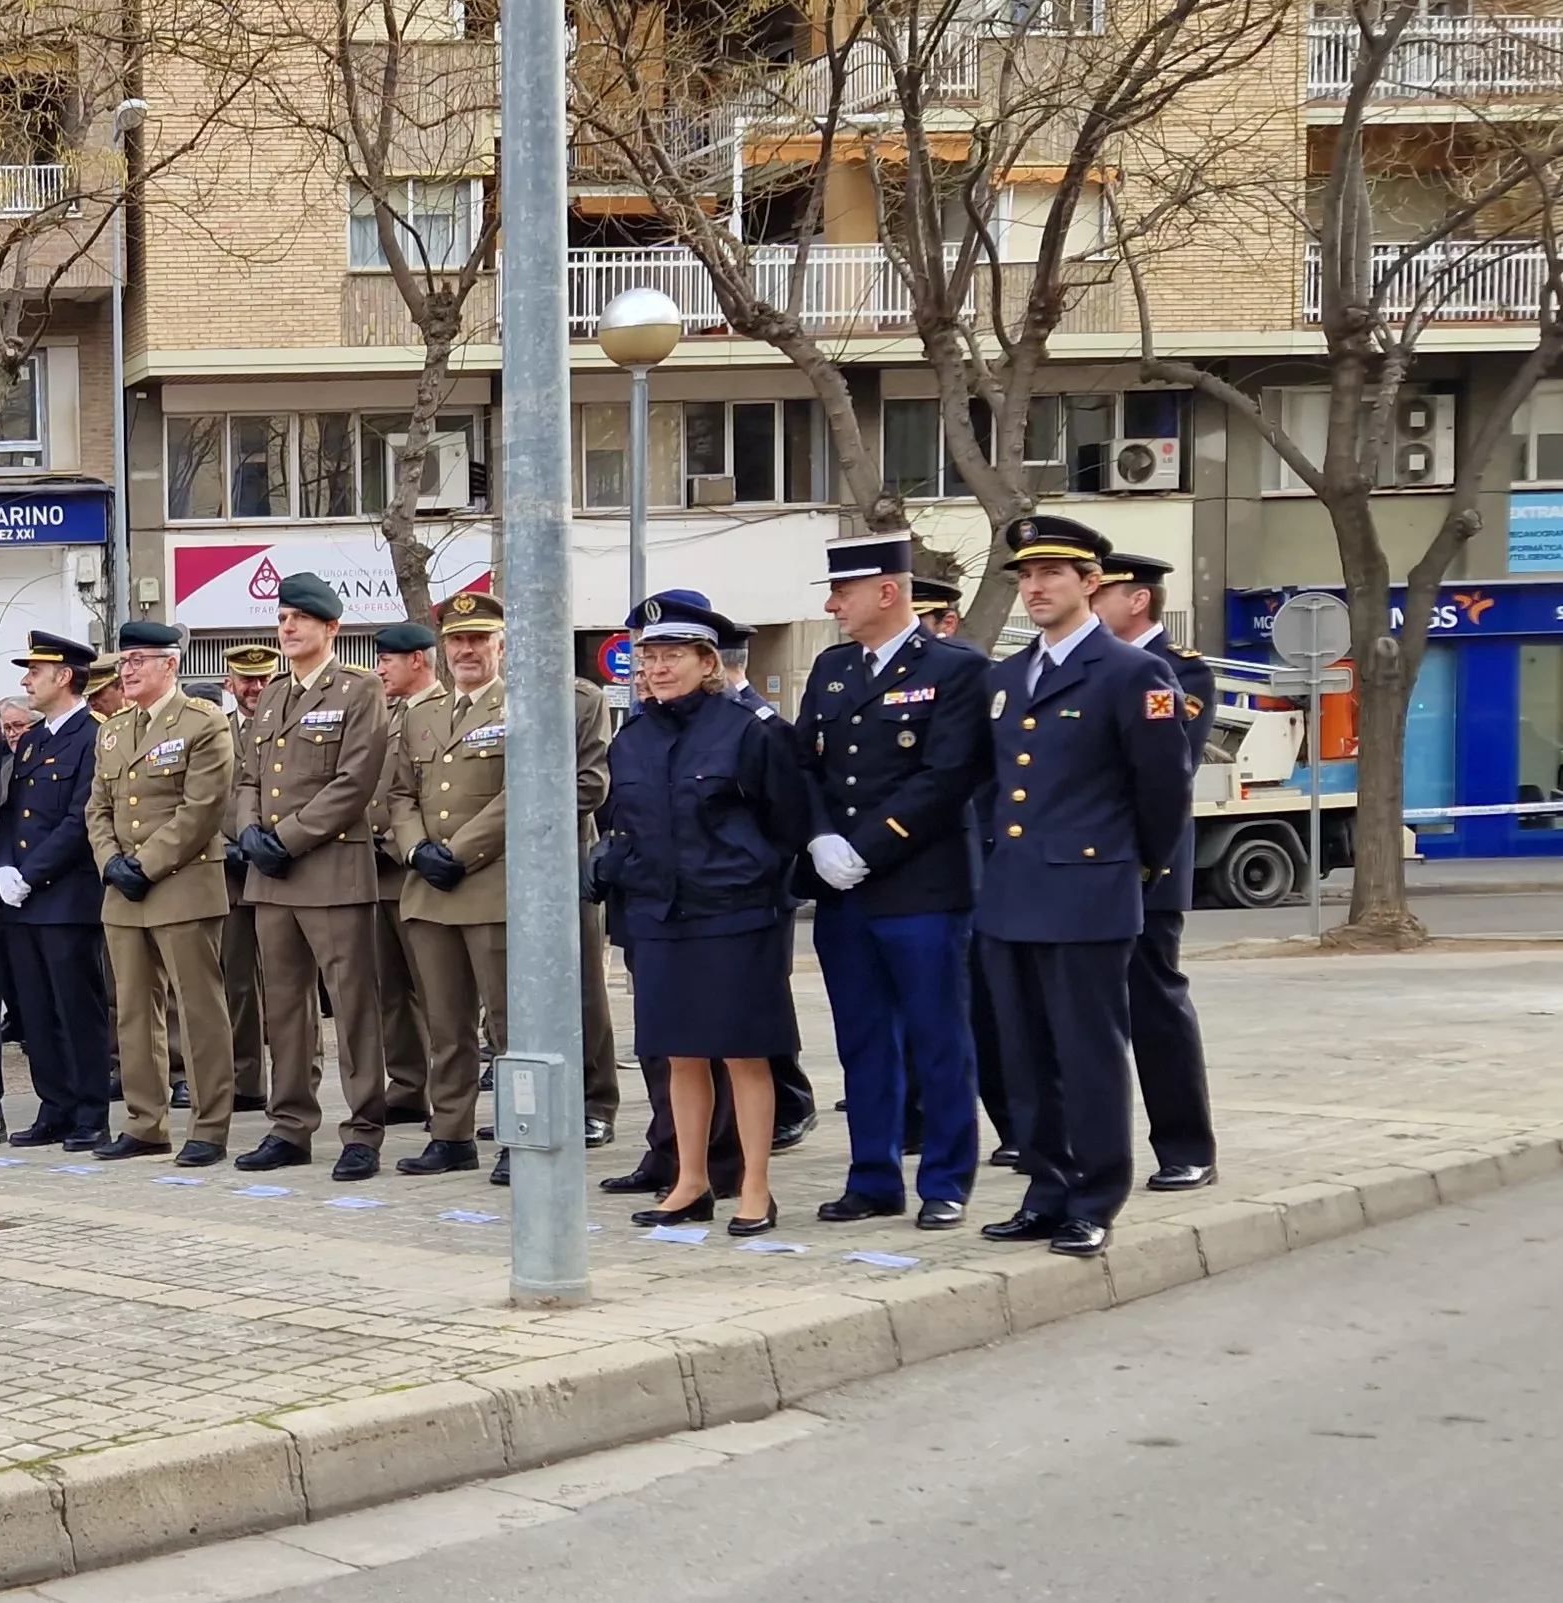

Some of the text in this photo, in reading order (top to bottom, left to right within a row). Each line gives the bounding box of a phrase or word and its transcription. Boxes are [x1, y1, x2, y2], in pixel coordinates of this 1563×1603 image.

[16, 528, 35, 540] XXI
[364, 602, 404, 611] PERSON
[1253, 615, 1275, 629] MG
